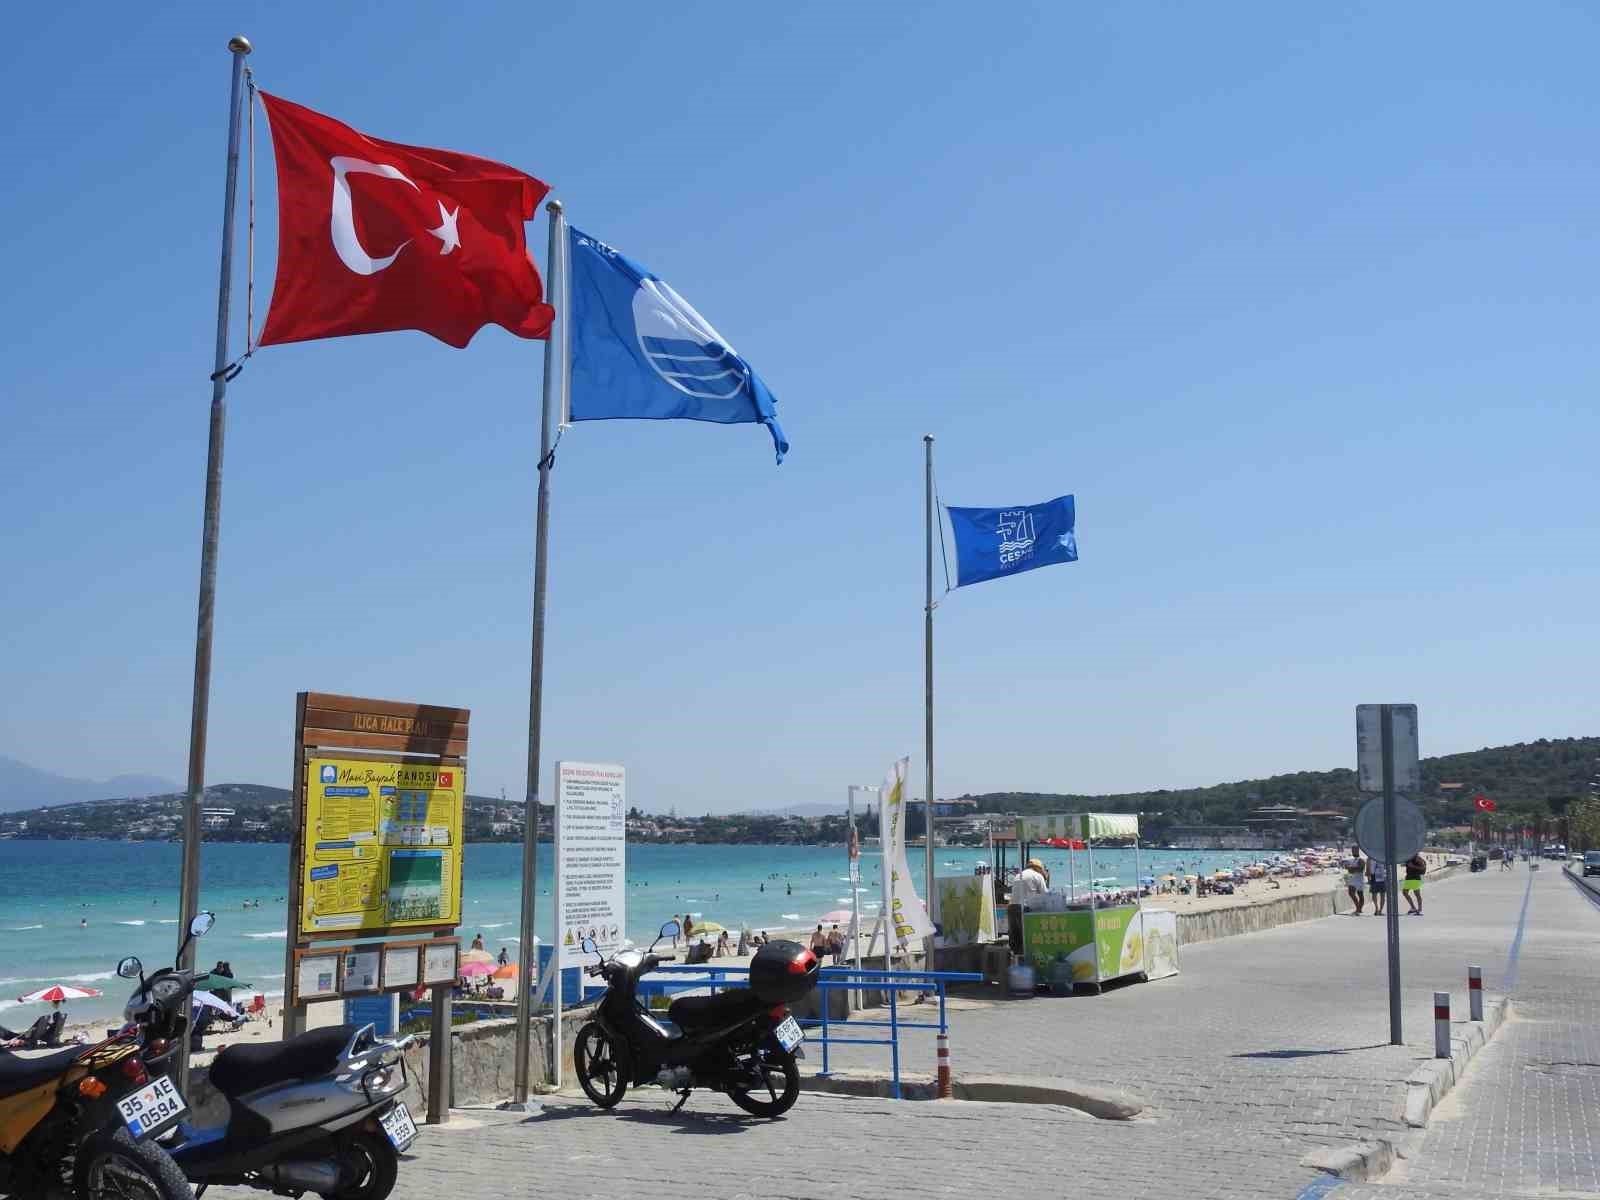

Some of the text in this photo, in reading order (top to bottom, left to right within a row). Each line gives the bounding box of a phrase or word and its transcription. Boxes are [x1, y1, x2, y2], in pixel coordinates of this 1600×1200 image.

[121, 1078, 173, 1117] 35 AE
[139, 1097, 179, 1128] 0594
